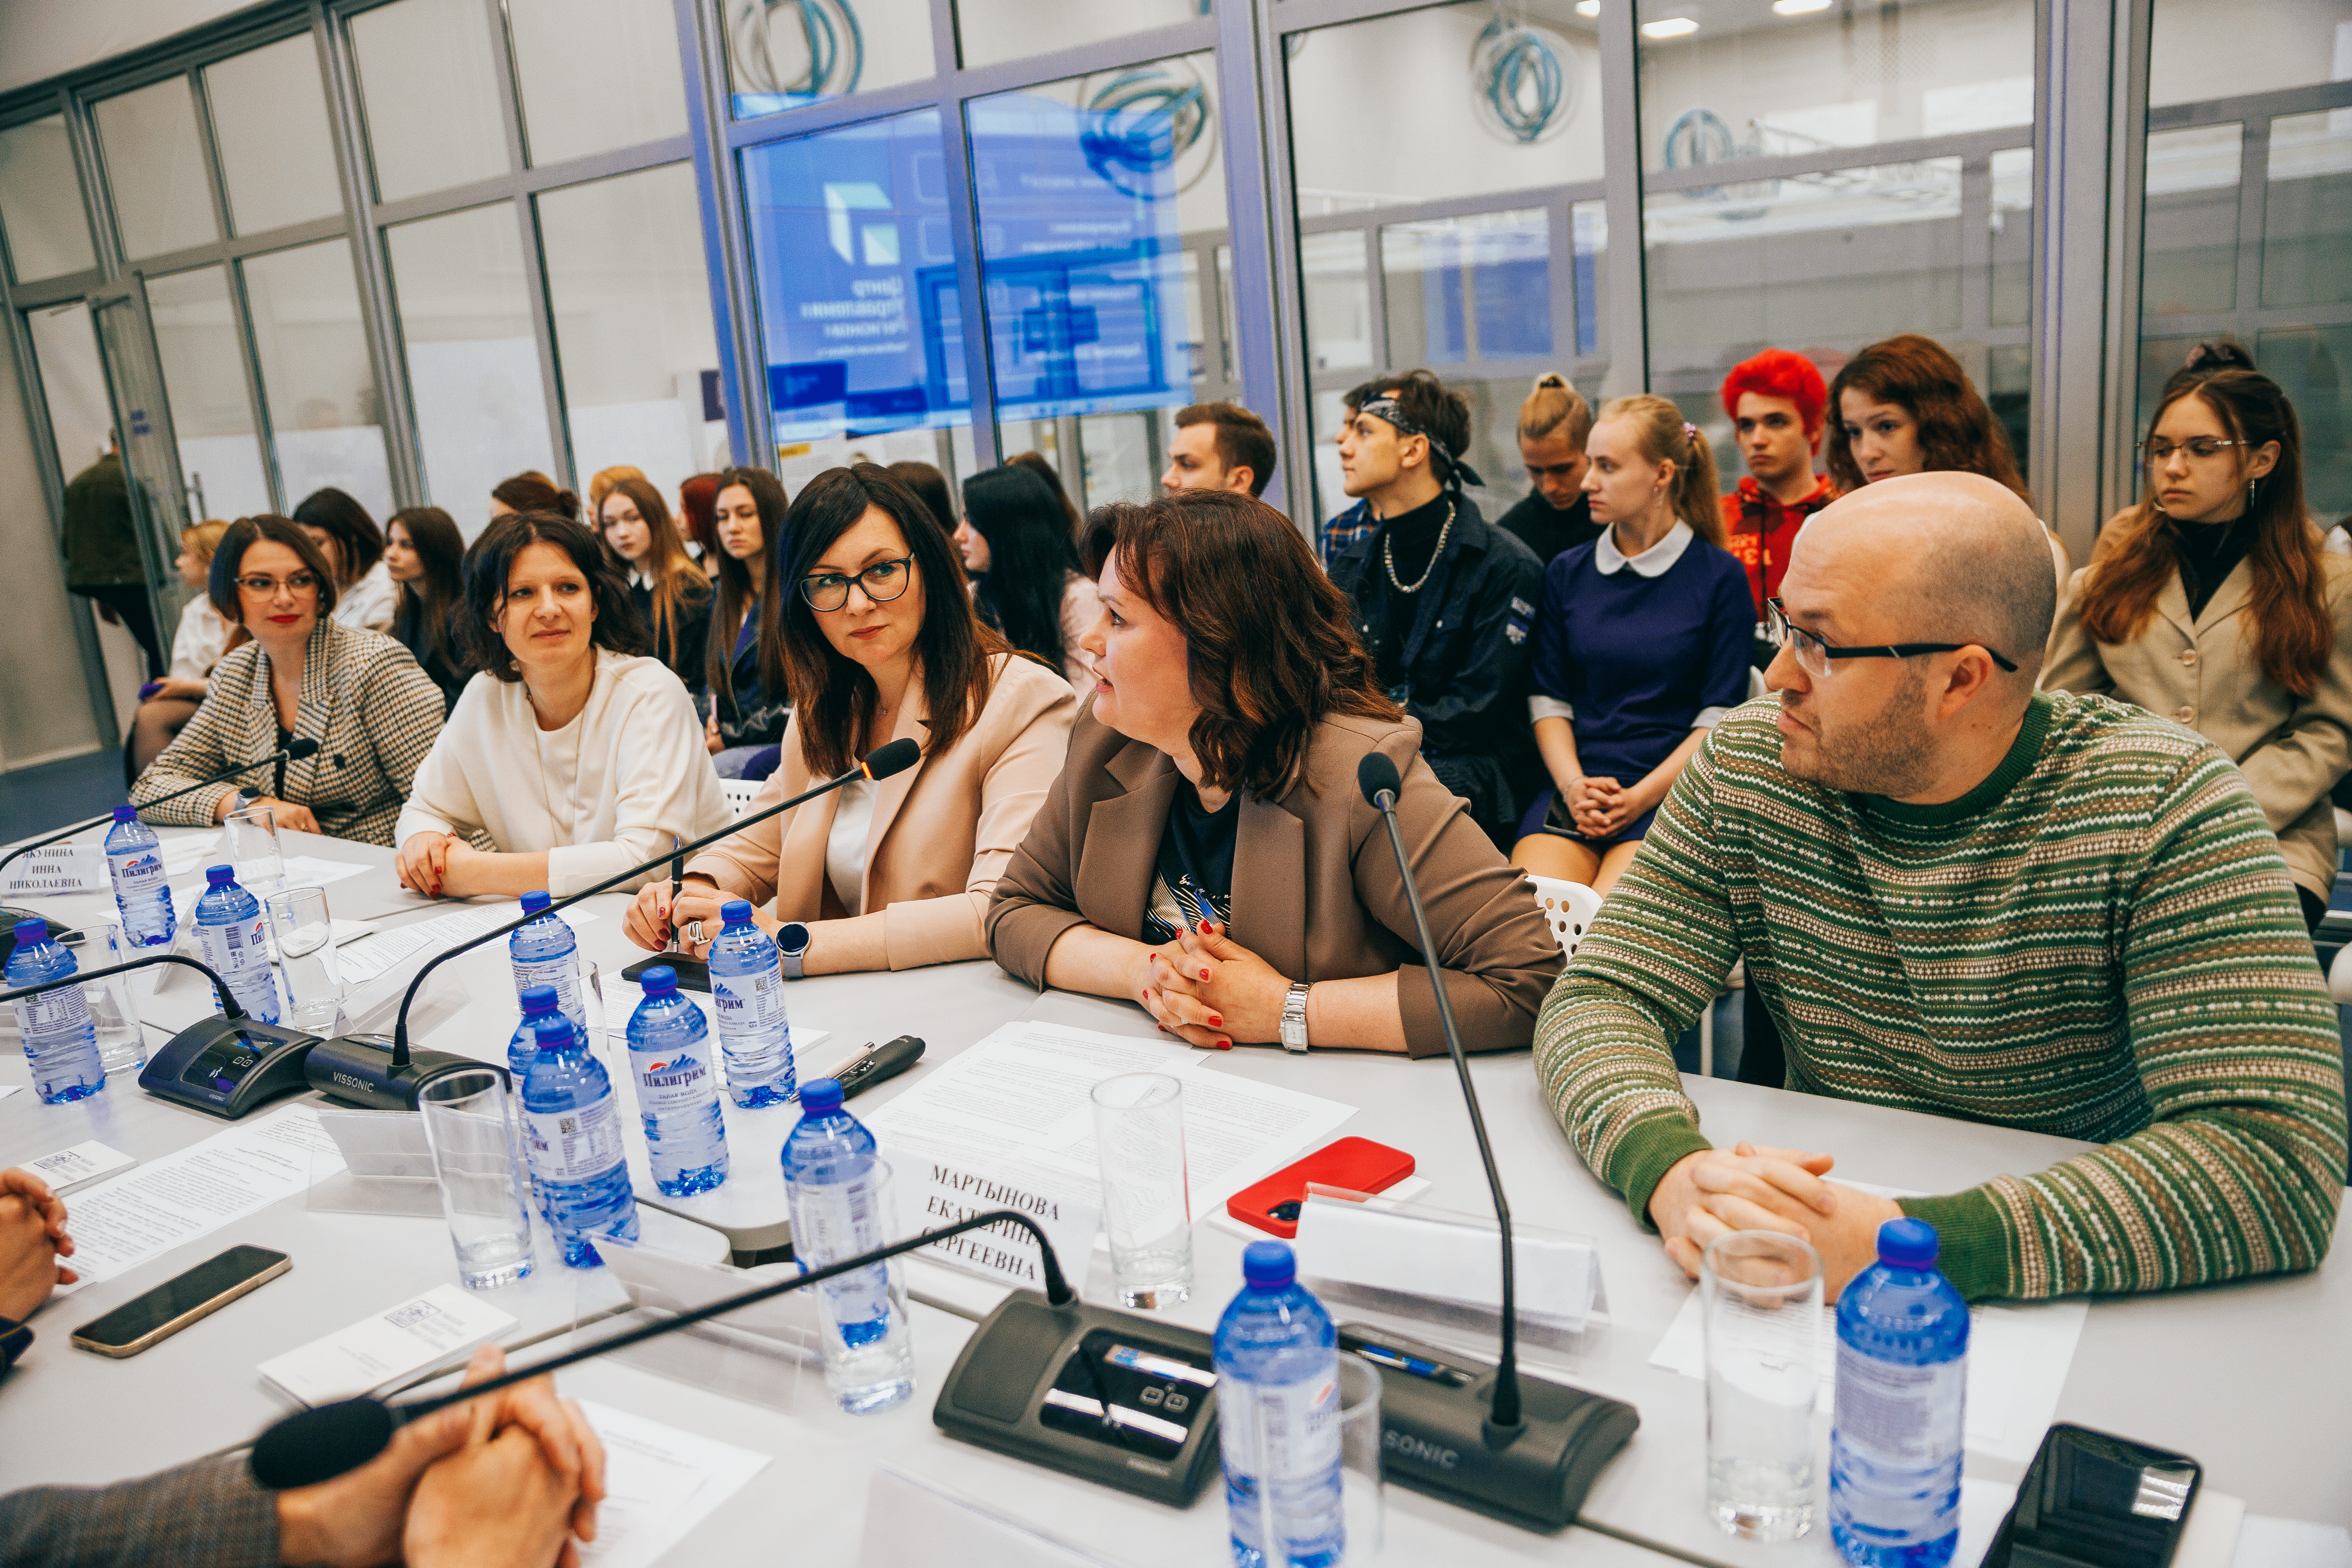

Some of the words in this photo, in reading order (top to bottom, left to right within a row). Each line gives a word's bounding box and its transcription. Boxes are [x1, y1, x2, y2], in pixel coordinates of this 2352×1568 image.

[22, 849, 74, 858] ЯКУНИНА
[32, 865, 62, 874] ИННА
[122, 864, 162, 878] Пилигрим
[9, 879, 83, 890] НИКОЛАЕВНА
[715, 997, 744, 1012] игрим
[334, 1072, 374, 1092] VISSONIC
[643, 1065, 707, 1087] Пилигрим
[929, 1164, 1060, 1220] МАРТЫНОВА
[926, 1194, 1040, 1246] ЕКАТРИН
[1384, 1429, 1459, 1470] SONIC
